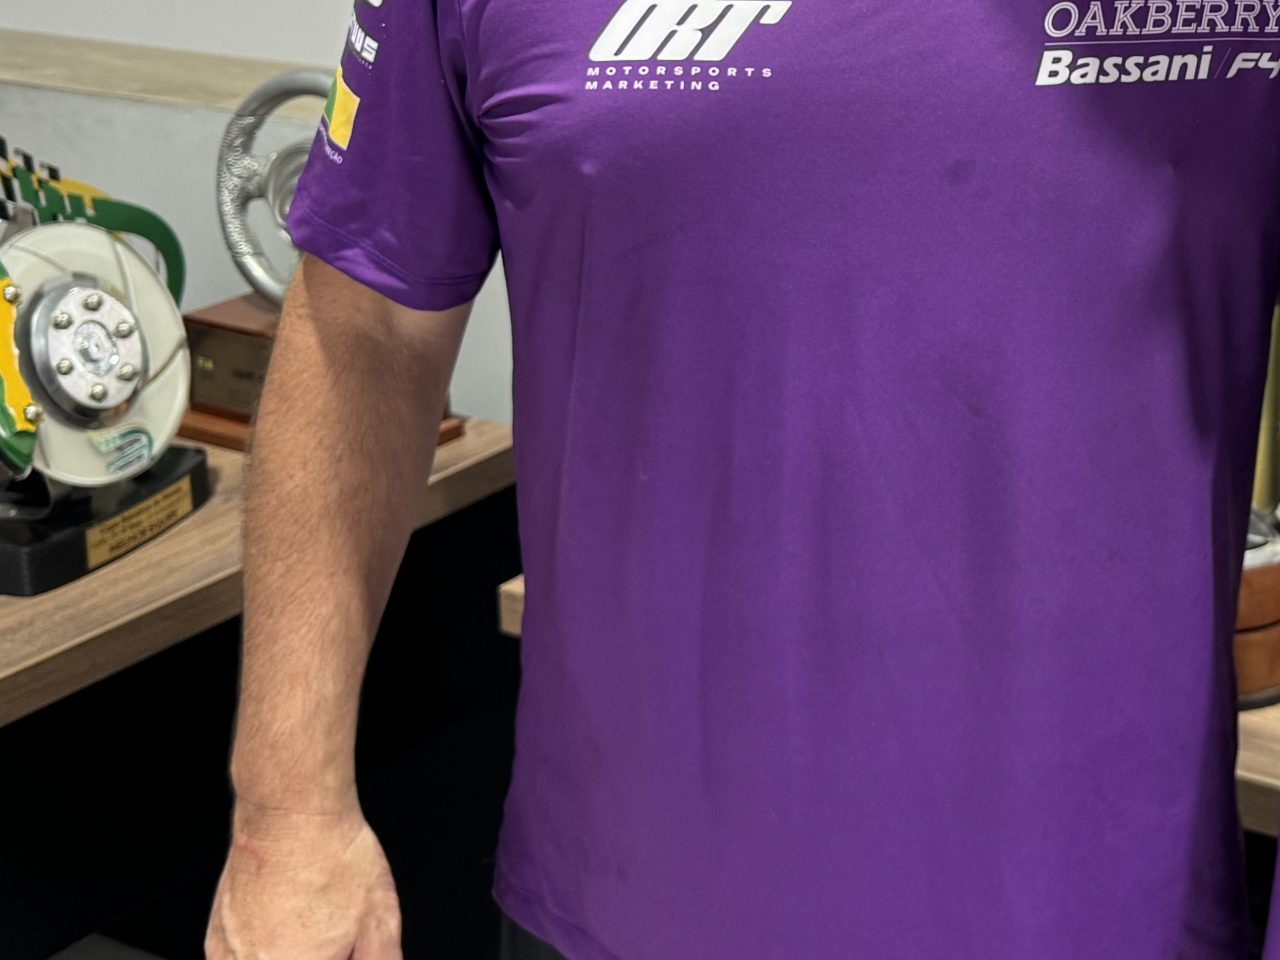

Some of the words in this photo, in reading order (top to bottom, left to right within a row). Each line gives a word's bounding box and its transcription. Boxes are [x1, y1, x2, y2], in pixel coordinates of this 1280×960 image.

[1035, 45, 1213, 86] Bassani
[586, 66, 773, 78] MOTORSPORTS
[585, 80, 720, 91] MARKETING
